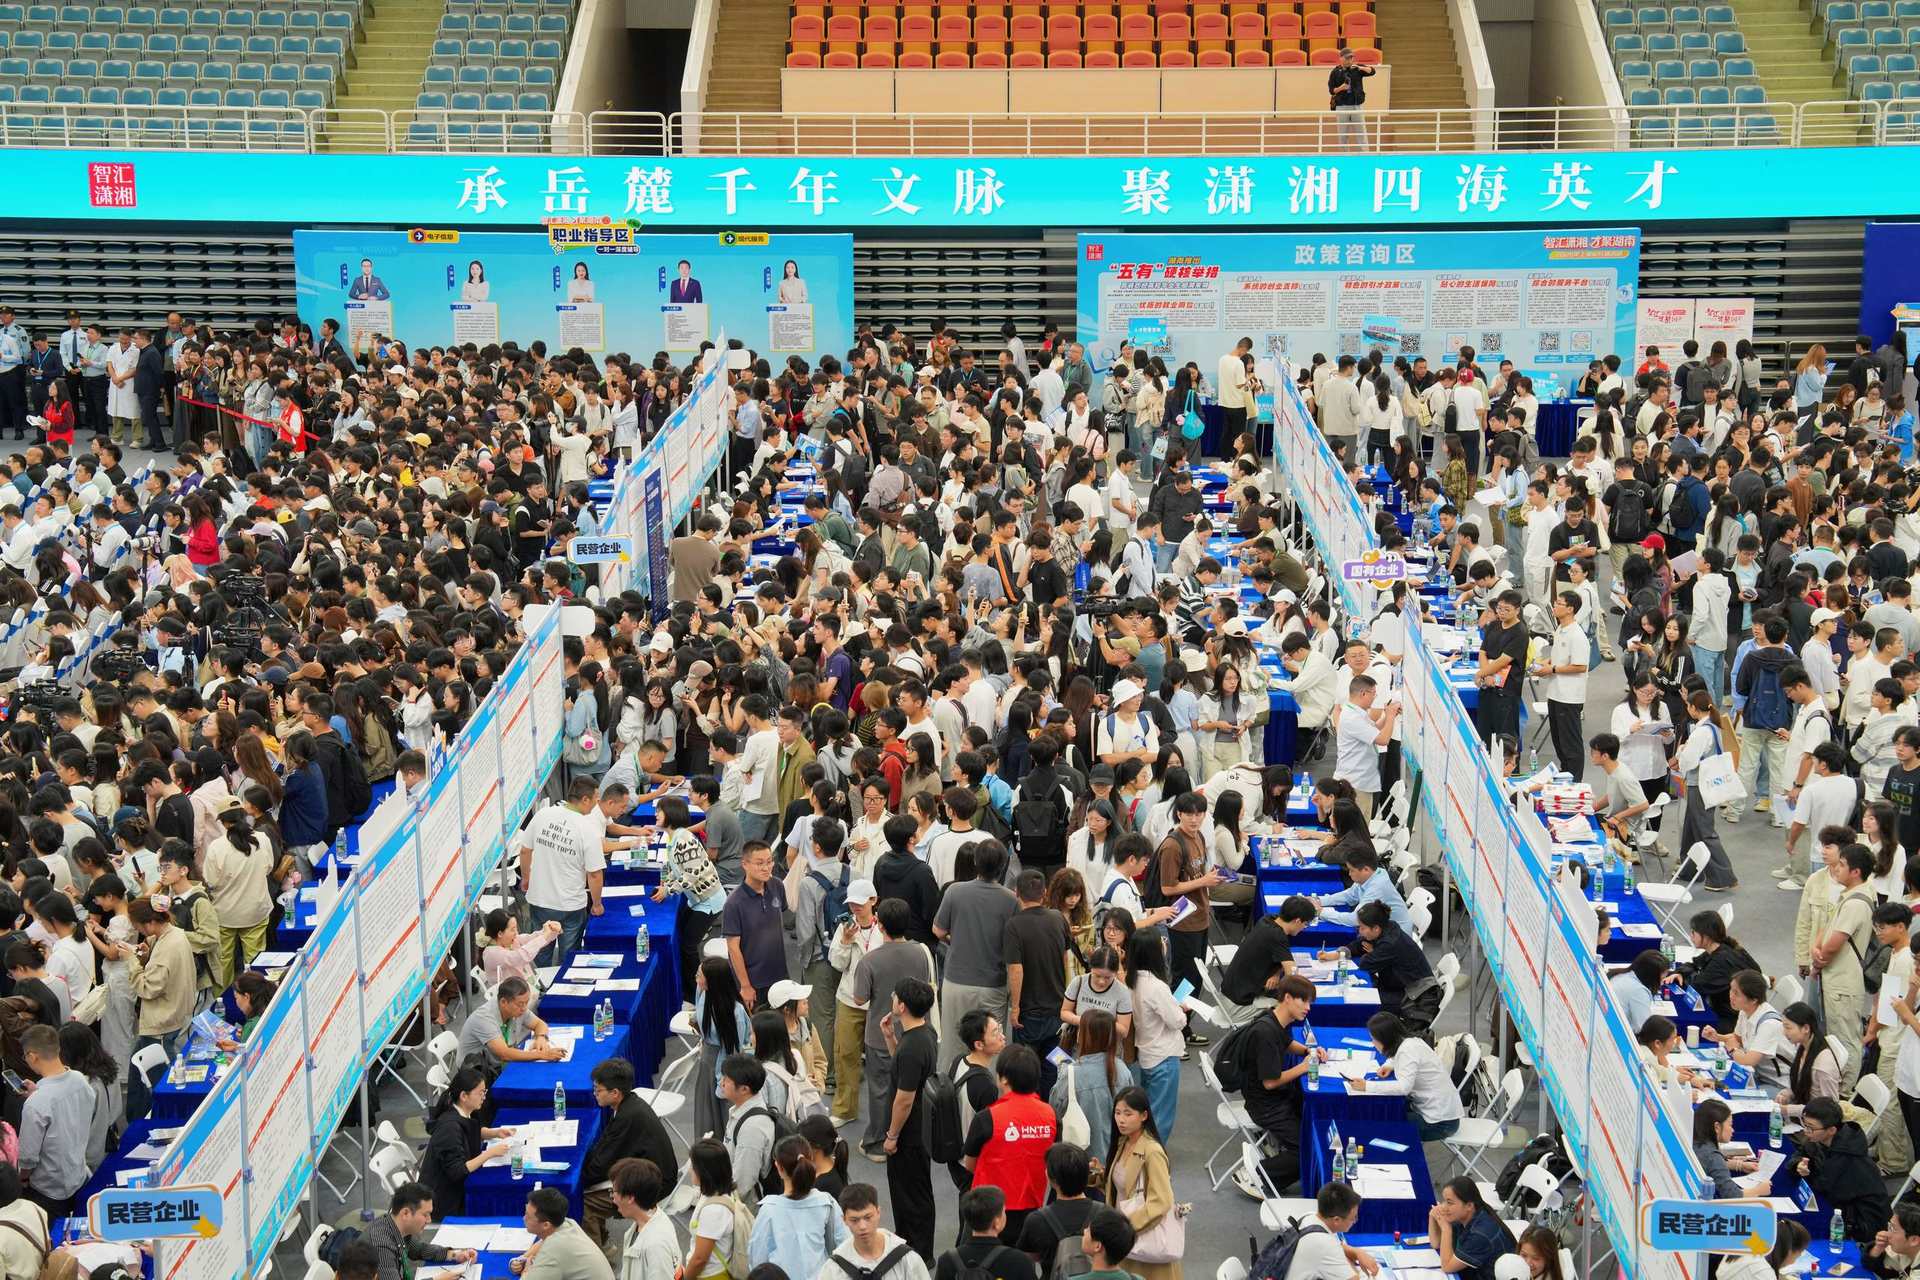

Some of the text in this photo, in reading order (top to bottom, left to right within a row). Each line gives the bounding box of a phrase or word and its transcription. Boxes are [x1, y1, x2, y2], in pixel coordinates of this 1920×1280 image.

[93, 164, 133, 184] 智汇
[94, 185, 134, 205] 潇湘
[457, 160, 1679, 213] 承岳麓千年文脉 聚潇湘四海英才
[552, 228, 629, 242] 职业指导区
[1294, 244, 1416, 264] 政策咨询区
[576, 541, 622, 555] 民营企业
[1351, 563, 1399, 577] 国有企业
[1081, 995, 1112, 1009] ROMANTIC
[107, 1199, 201, 1225] 民营企业
[1658, 1212, 1753, 1236] 民营企业
